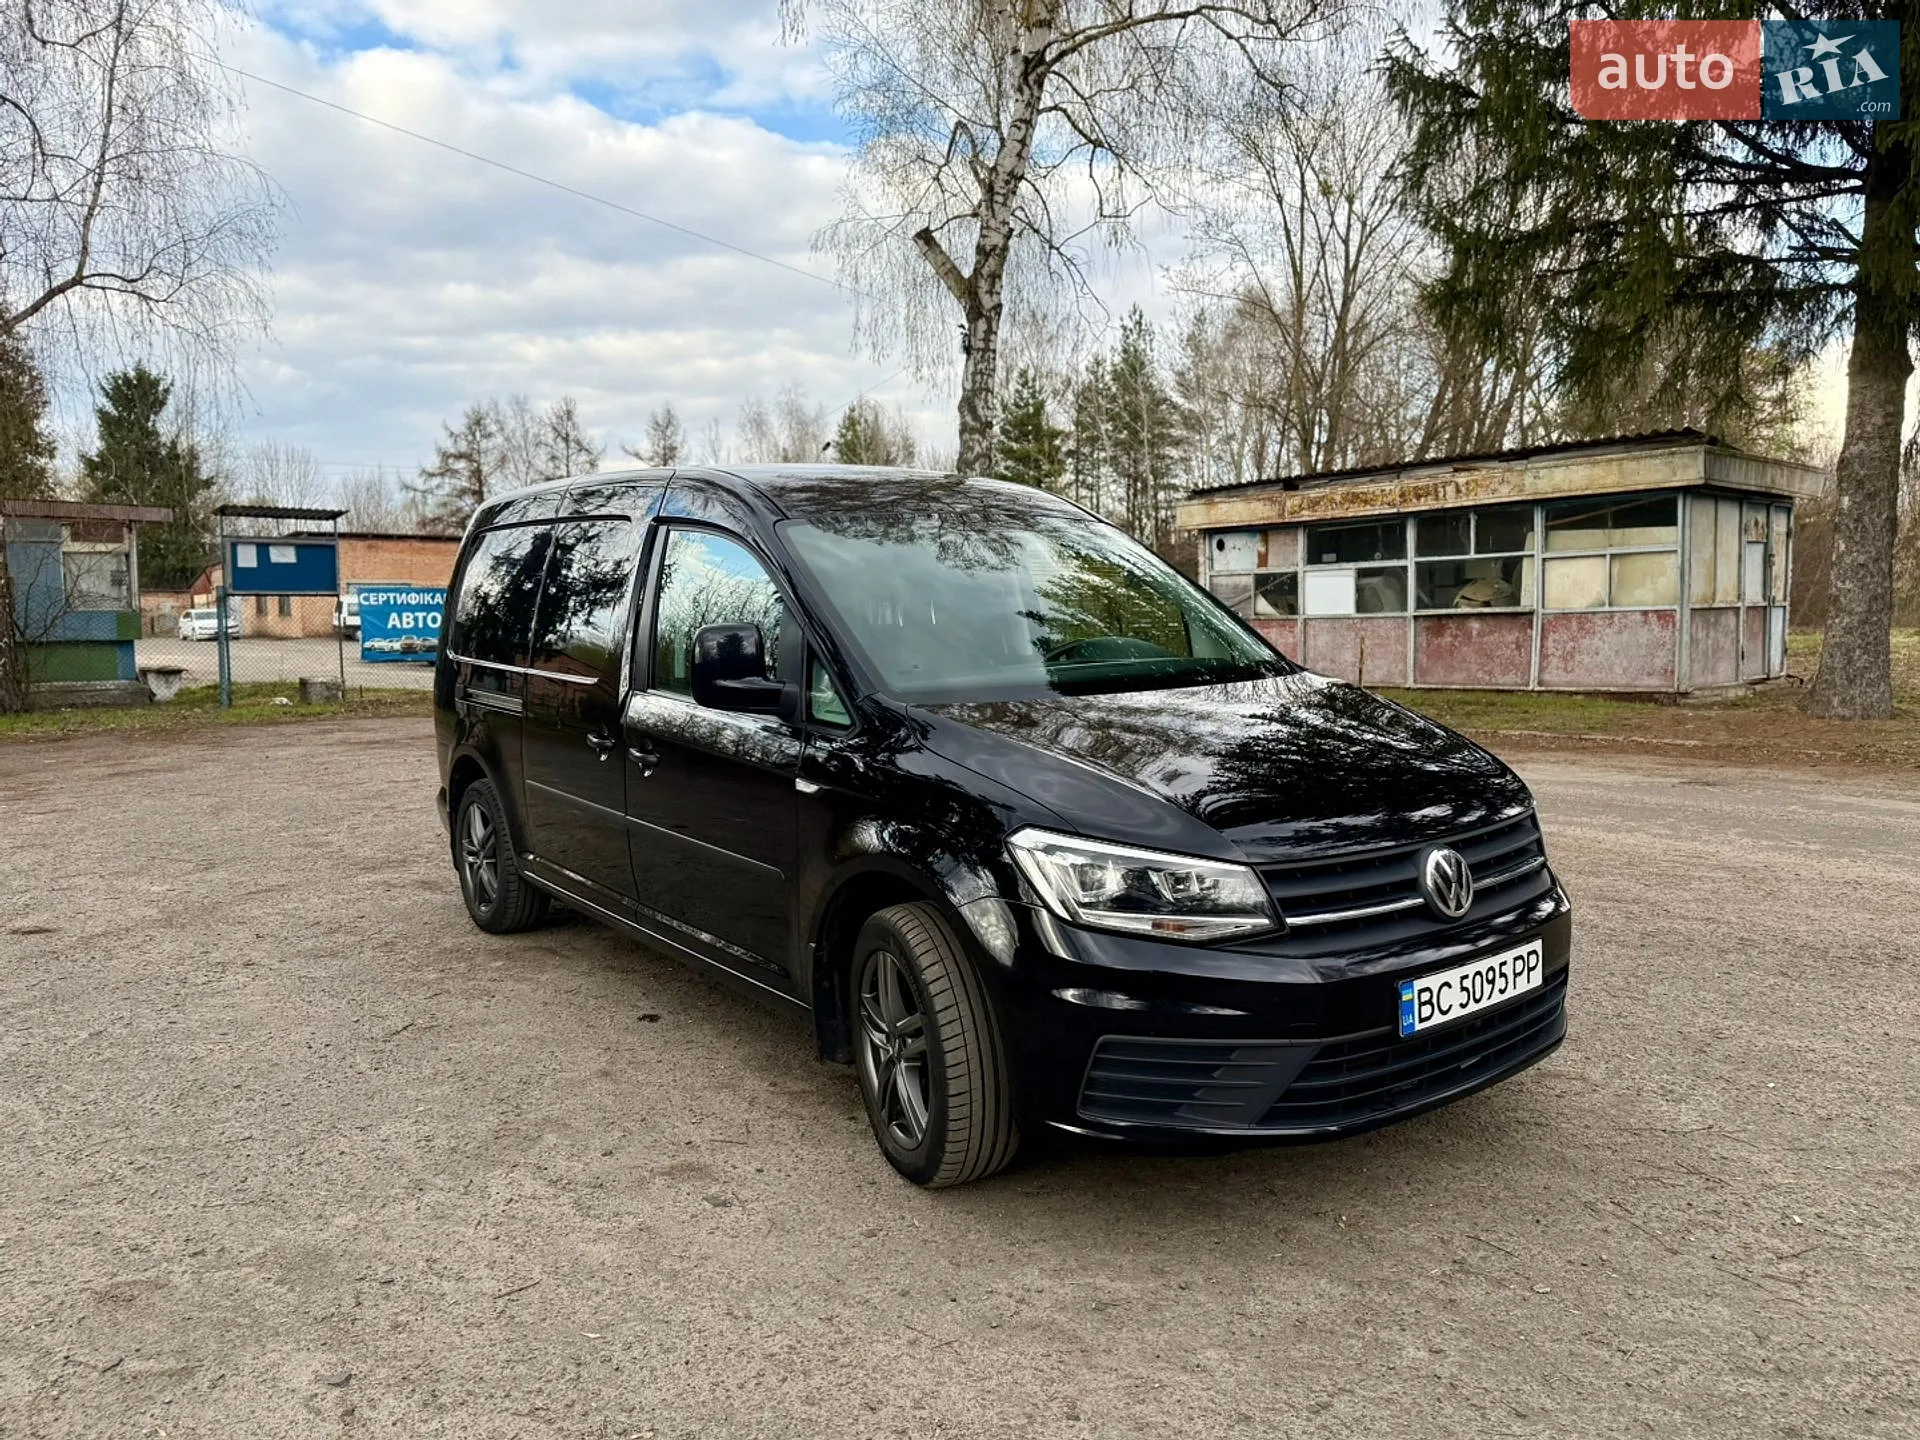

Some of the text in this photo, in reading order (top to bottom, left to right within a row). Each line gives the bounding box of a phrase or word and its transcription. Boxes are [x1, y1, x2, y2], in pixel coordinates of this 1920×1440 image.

[387, 611, 442, 629] АВТО
[1417, 949, 1540, 1024] BC 5095 PP
